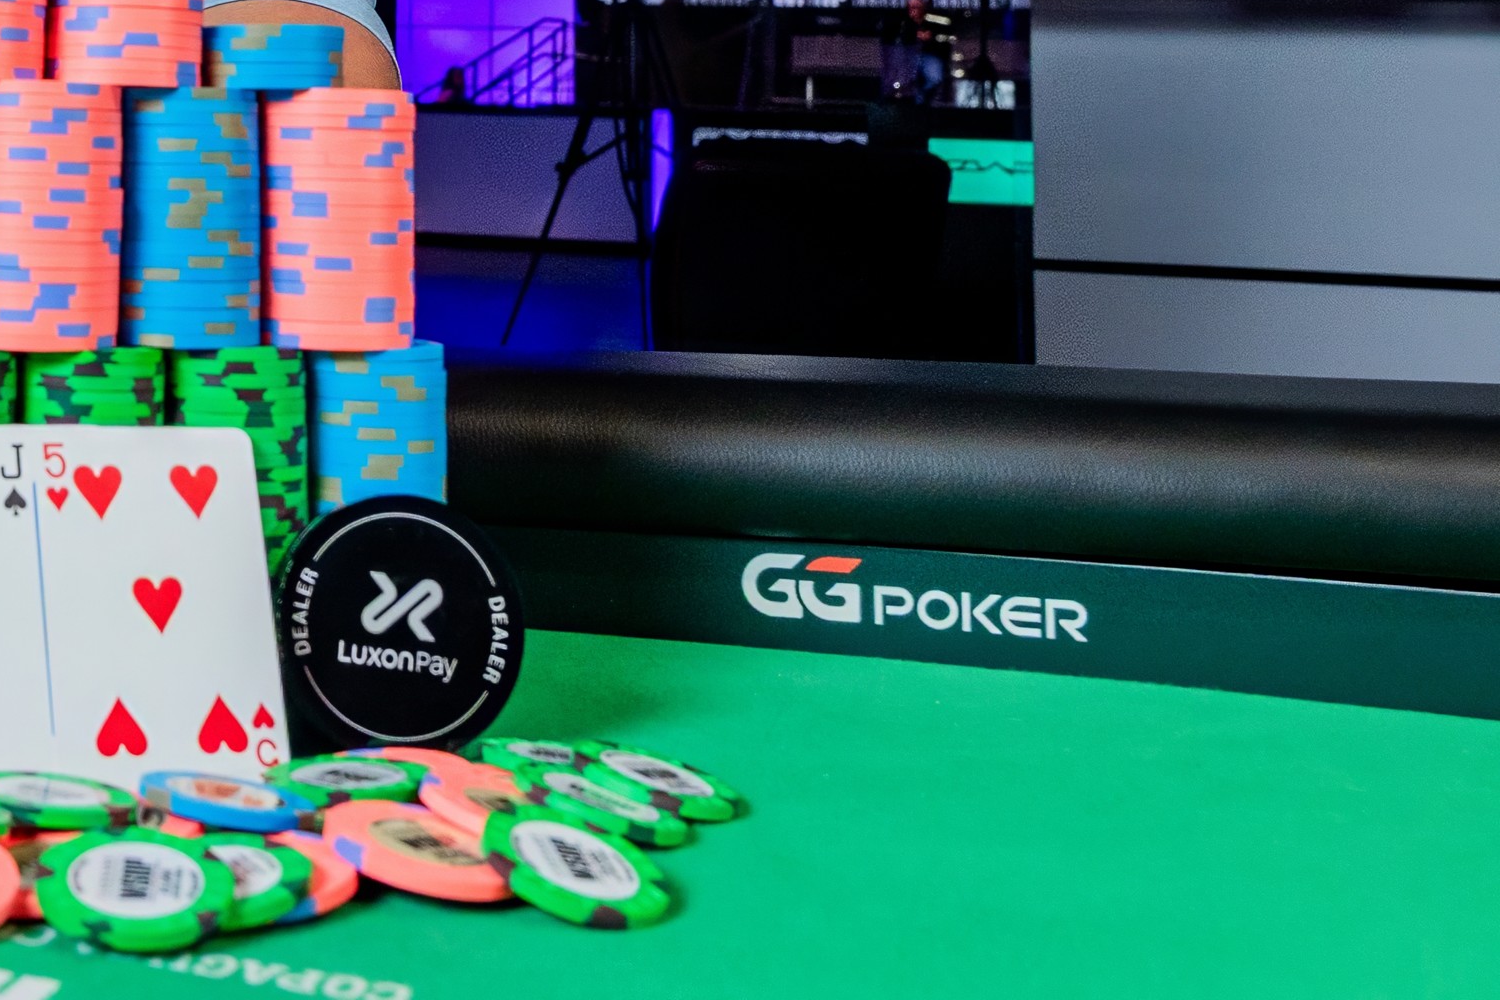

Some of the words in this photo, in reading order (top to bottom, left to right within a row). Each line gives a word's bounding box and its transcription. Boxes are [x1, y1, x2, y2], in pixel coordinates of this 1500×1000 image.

[0, 444, 23, 479] J
[43, 443, 66, 478] 5
[291, 566, 320, 657] DEALER
[483, 595, 511, 685] DEALER
[337, 638, 459, 684] LuxonPay
